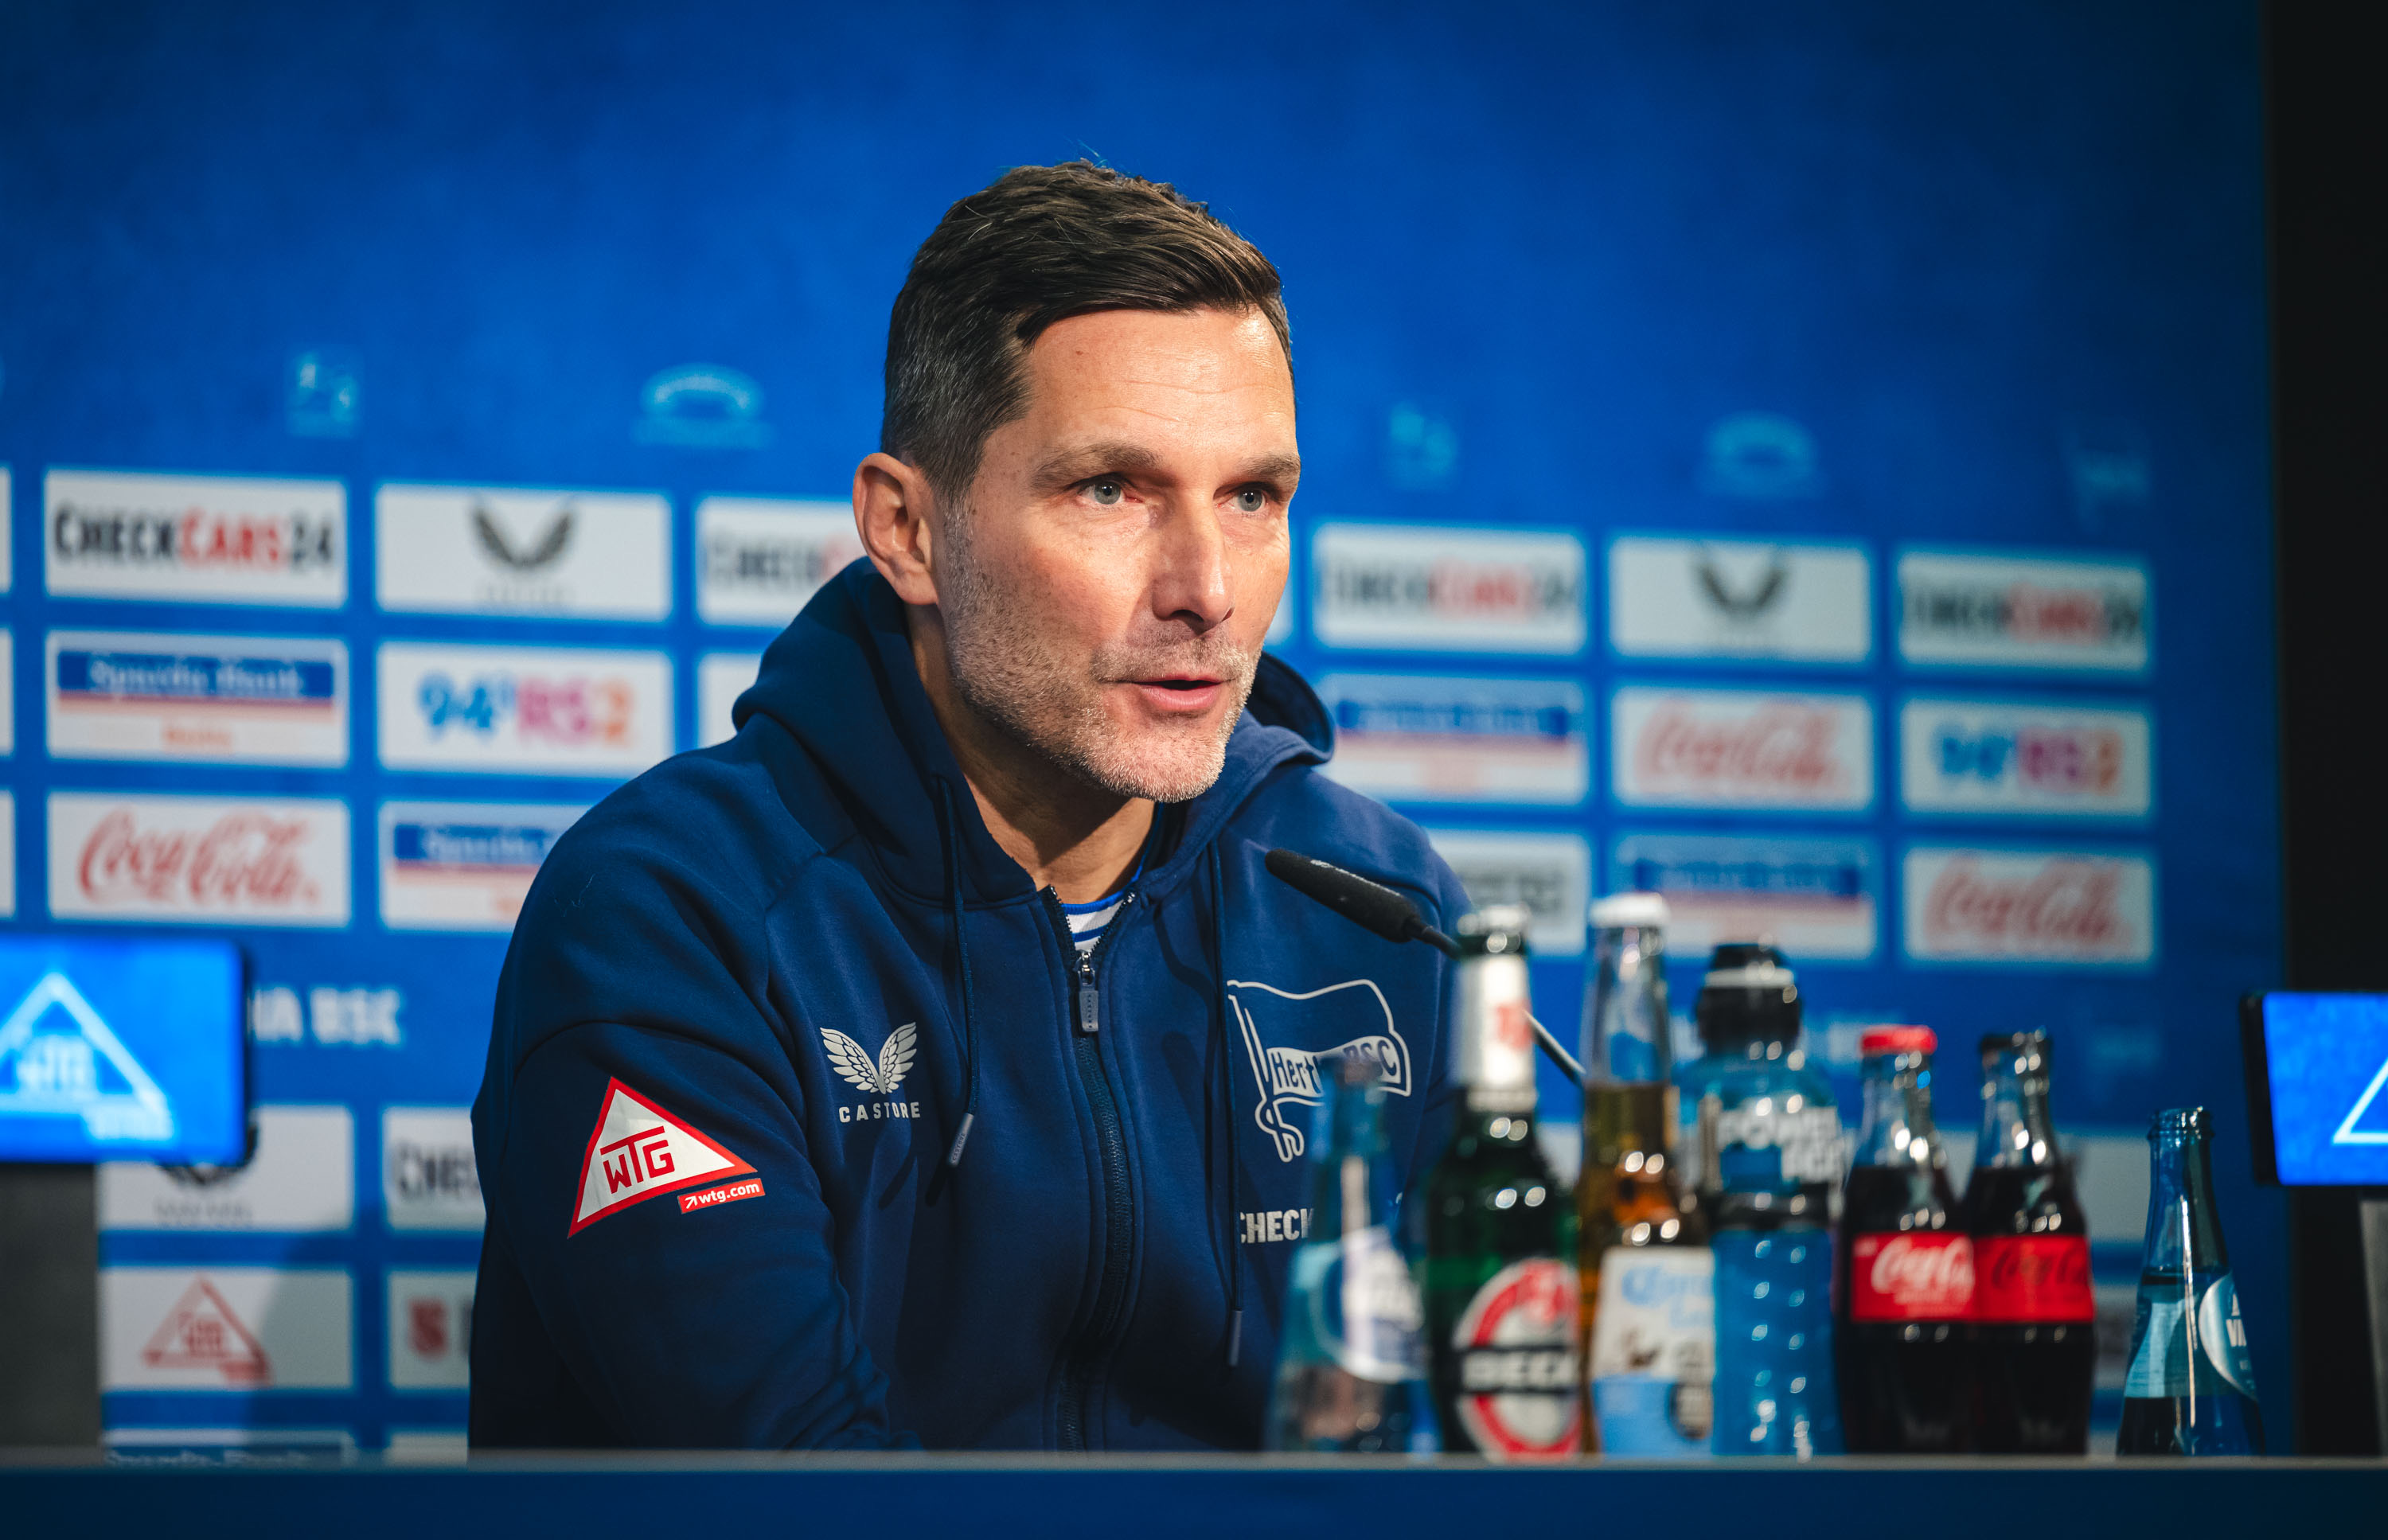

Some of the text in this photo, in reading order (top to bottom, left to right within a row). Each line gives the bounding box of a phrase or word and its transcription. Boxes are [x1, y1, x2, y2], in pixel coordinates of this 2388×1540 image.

[56, 503, 332, 568] CHECKCARS24
[76, 805, 312, 907] Coca-Cola
[838, 1101, 921, 1123] CASTORE
[600, 1125, 675, 1195] WTG
[698, 1183, 760, 1203] wtg.com
